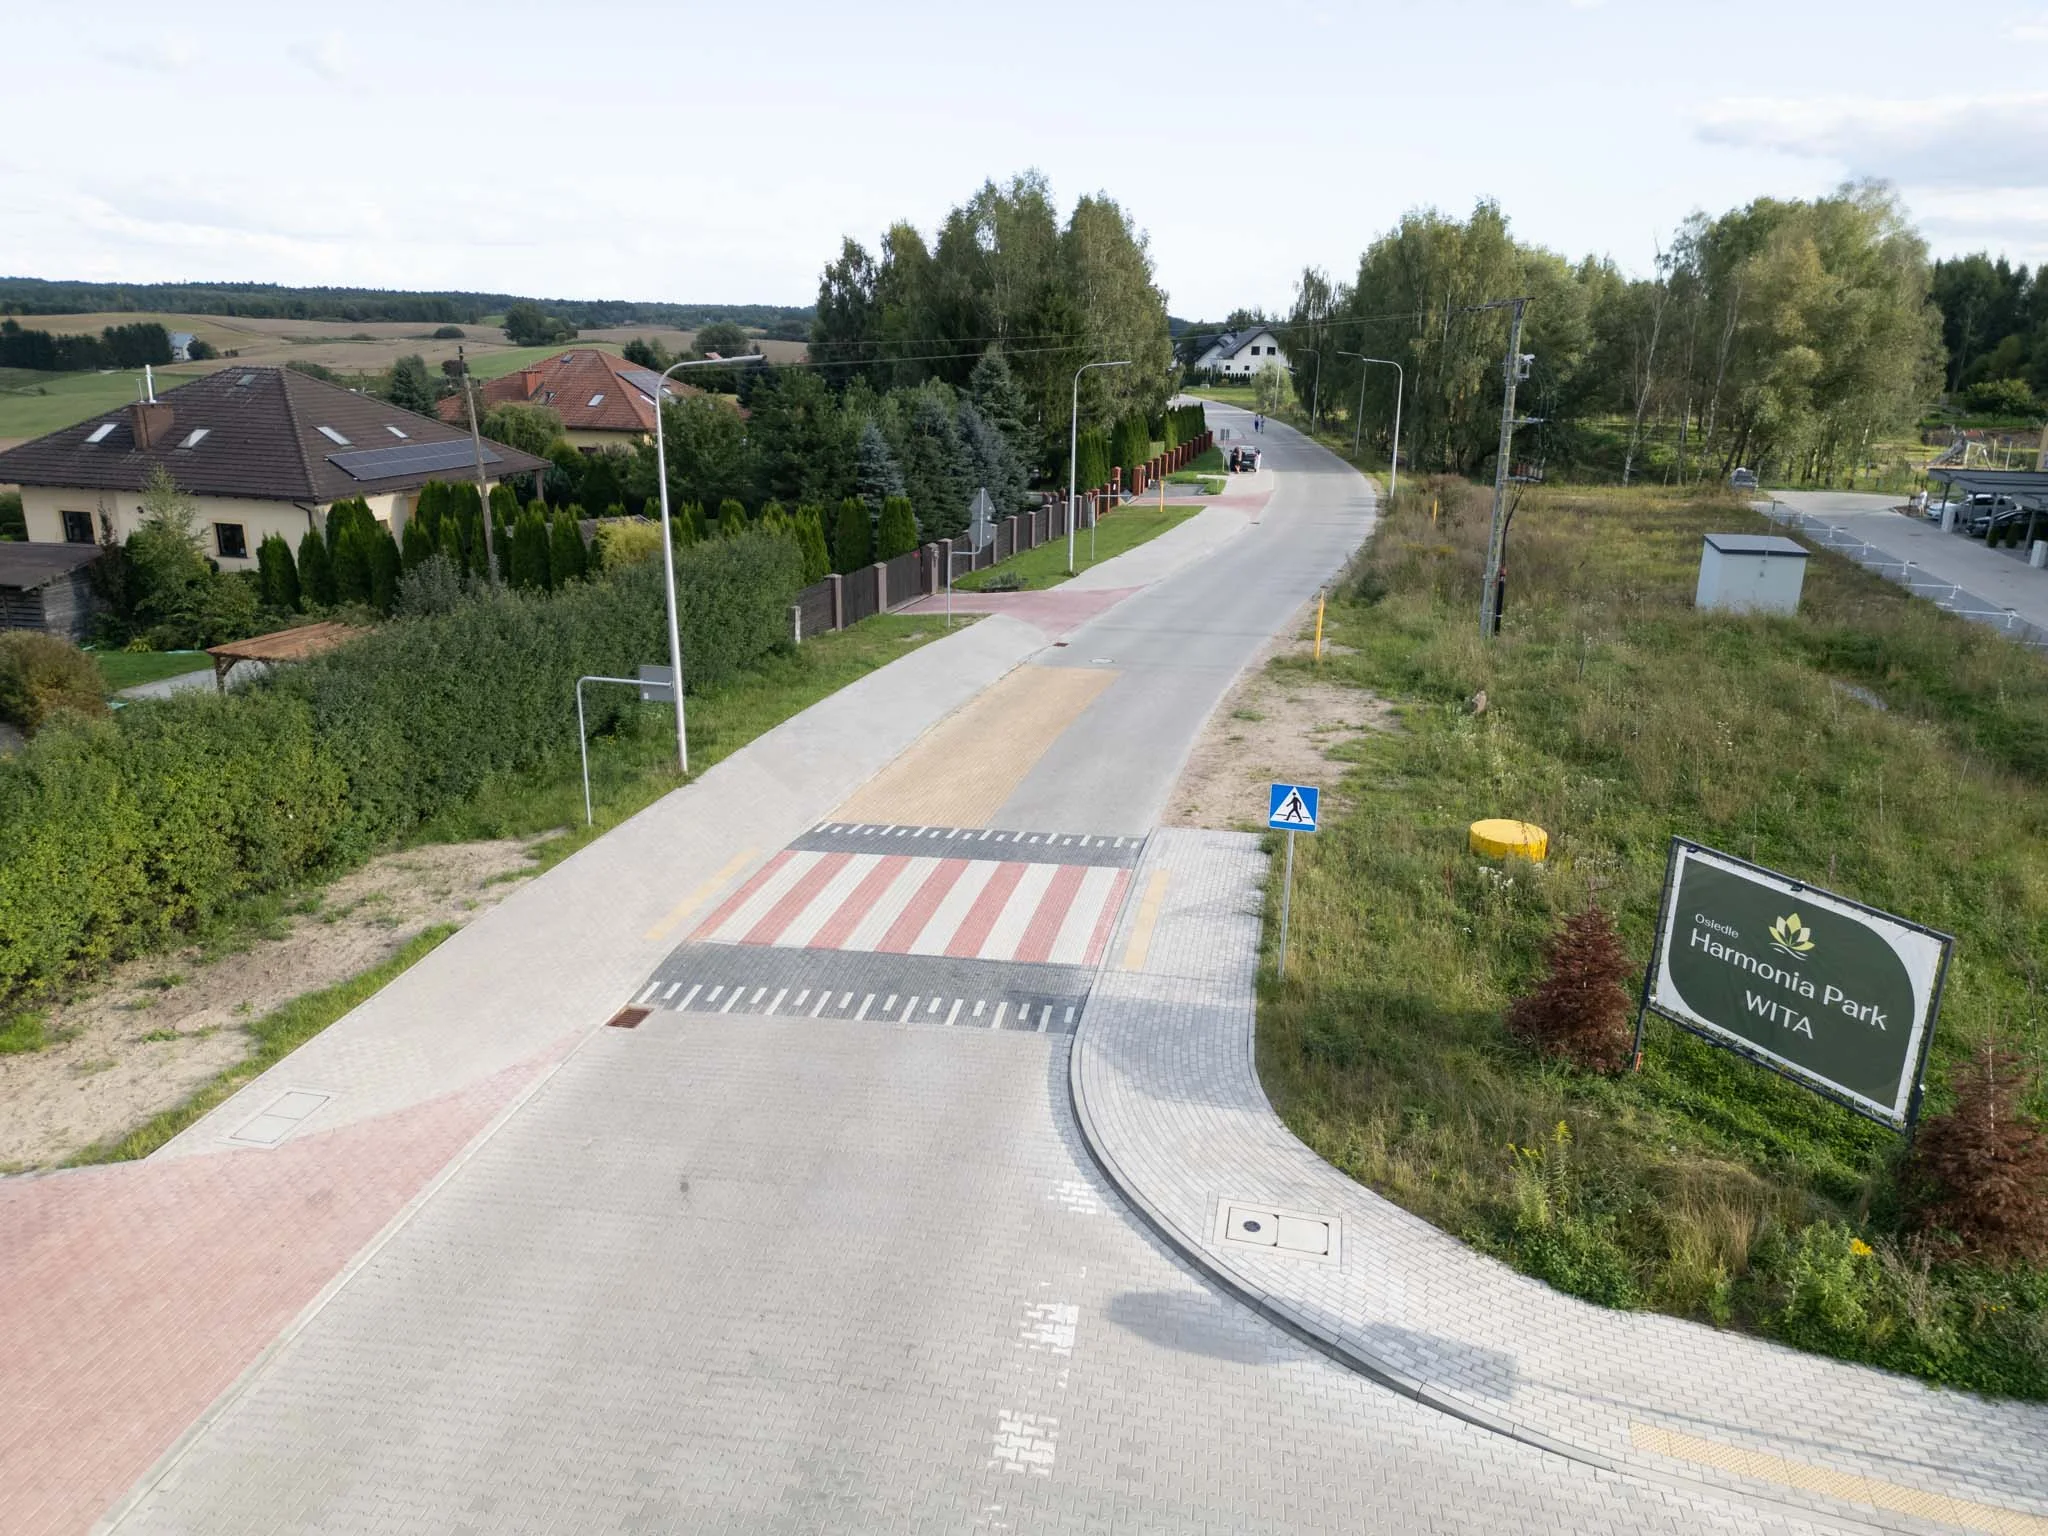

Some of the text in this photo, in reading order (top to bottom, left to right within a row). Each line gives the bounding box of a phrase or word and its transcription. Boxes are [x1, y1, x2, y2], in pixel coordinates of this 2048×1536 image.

[1695, 913, 1739, 939] Osiedle
[1690, 928, 1887, 1031] Harmonia Park
[1745, 989, 1814, 1040] WITA
